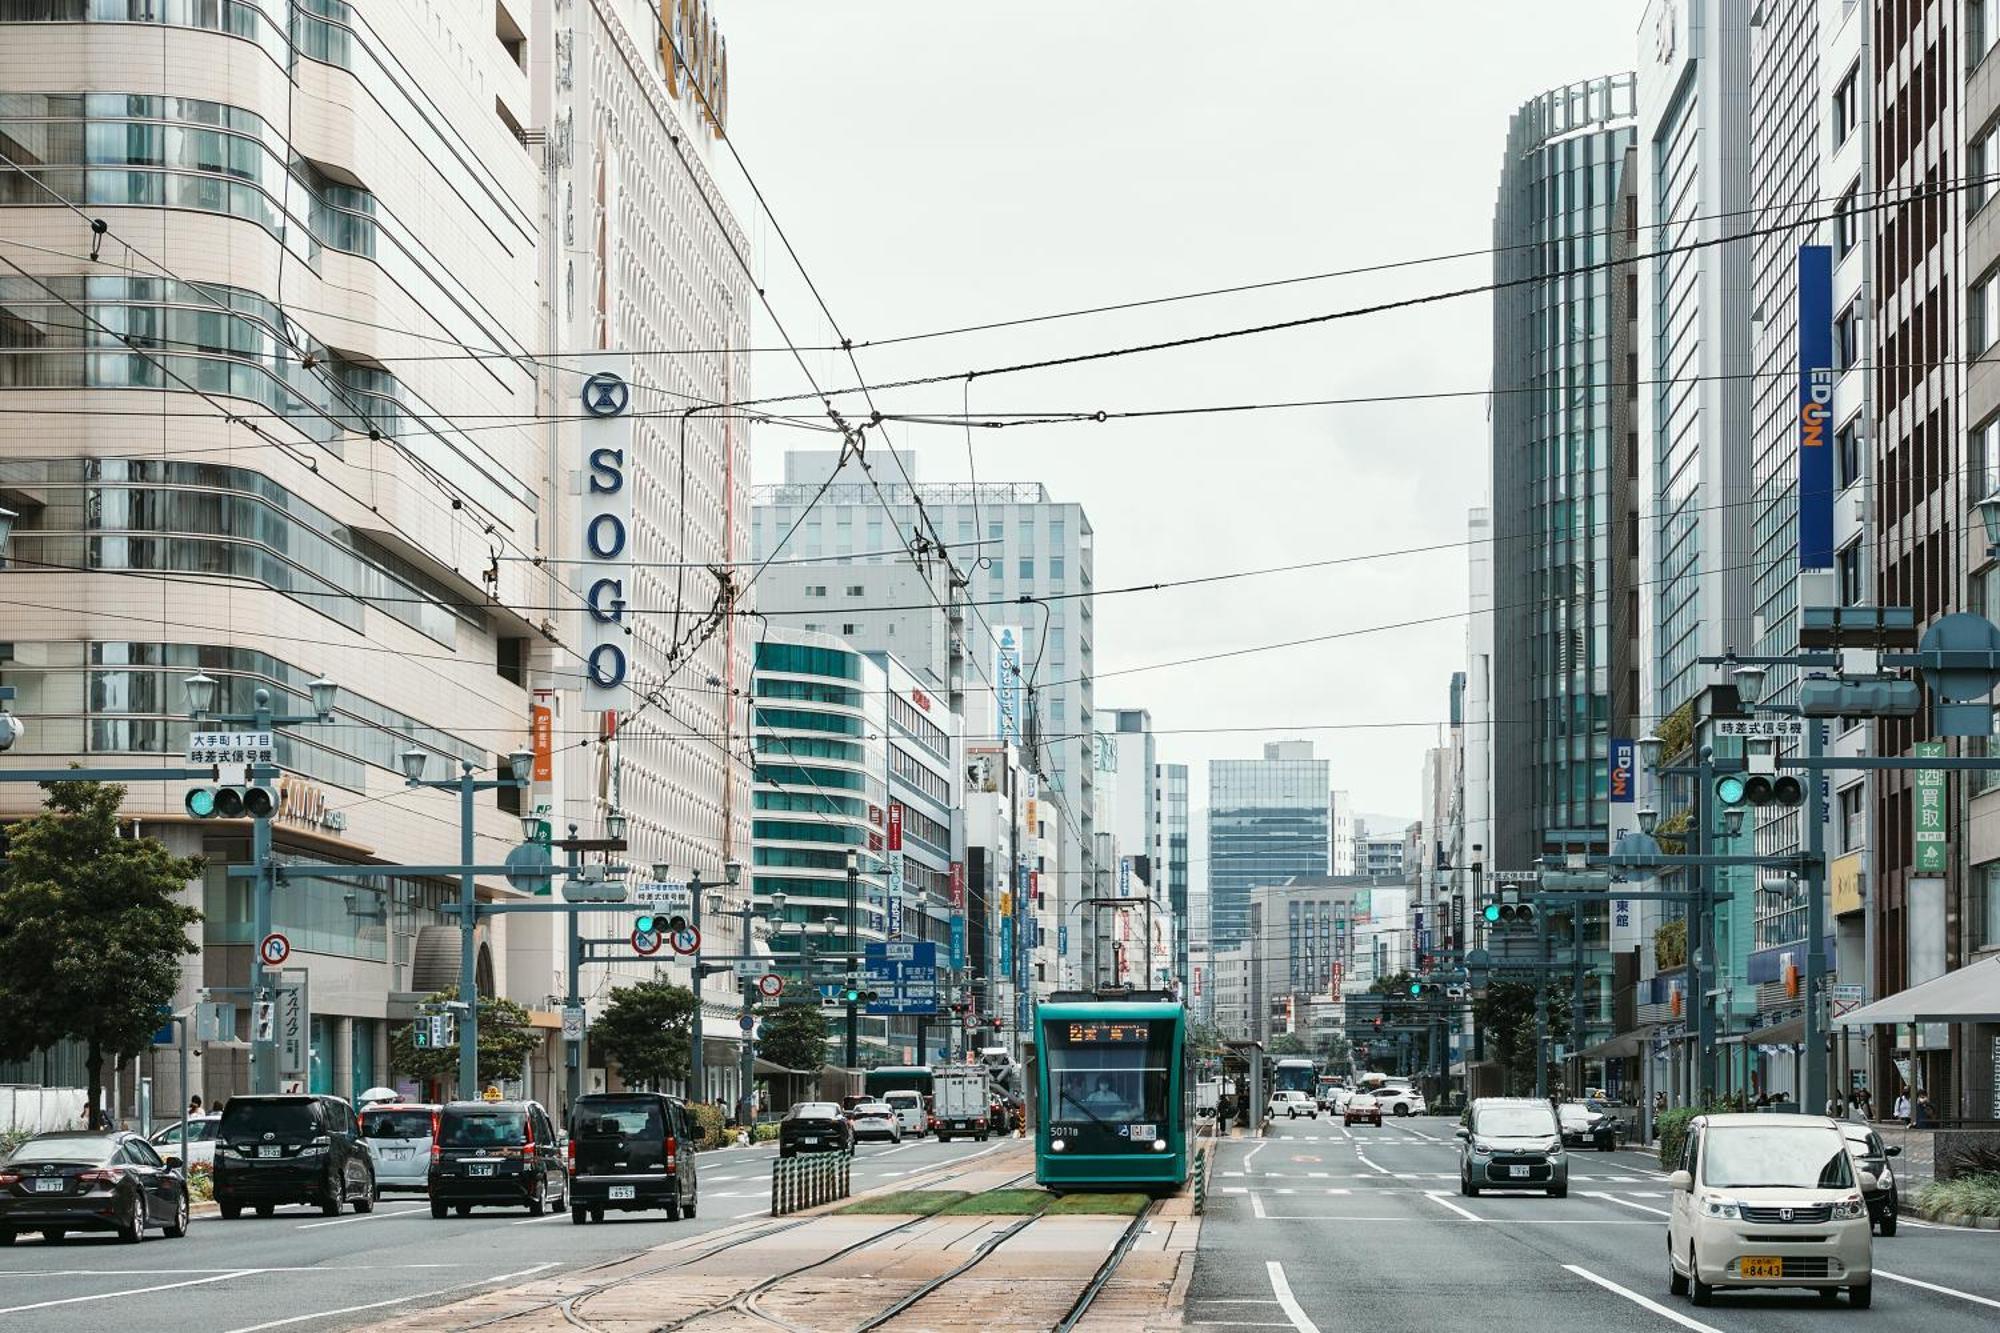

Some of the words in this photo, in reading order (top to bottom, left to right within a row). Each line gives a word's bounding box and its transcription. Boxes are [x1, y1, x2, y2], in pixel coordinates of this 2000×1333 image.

[587, 447, 626, 689] SOGO
[1721, 722, 1802, 734] 時差式信号機
[194, 735, 270, 747] 大手町1丁目
[191, 750, 272, 763] 時差式信号機
[285, 988, 299, 1036] メルパルク
[1750, 1265, 1780, 1277] 84-43
